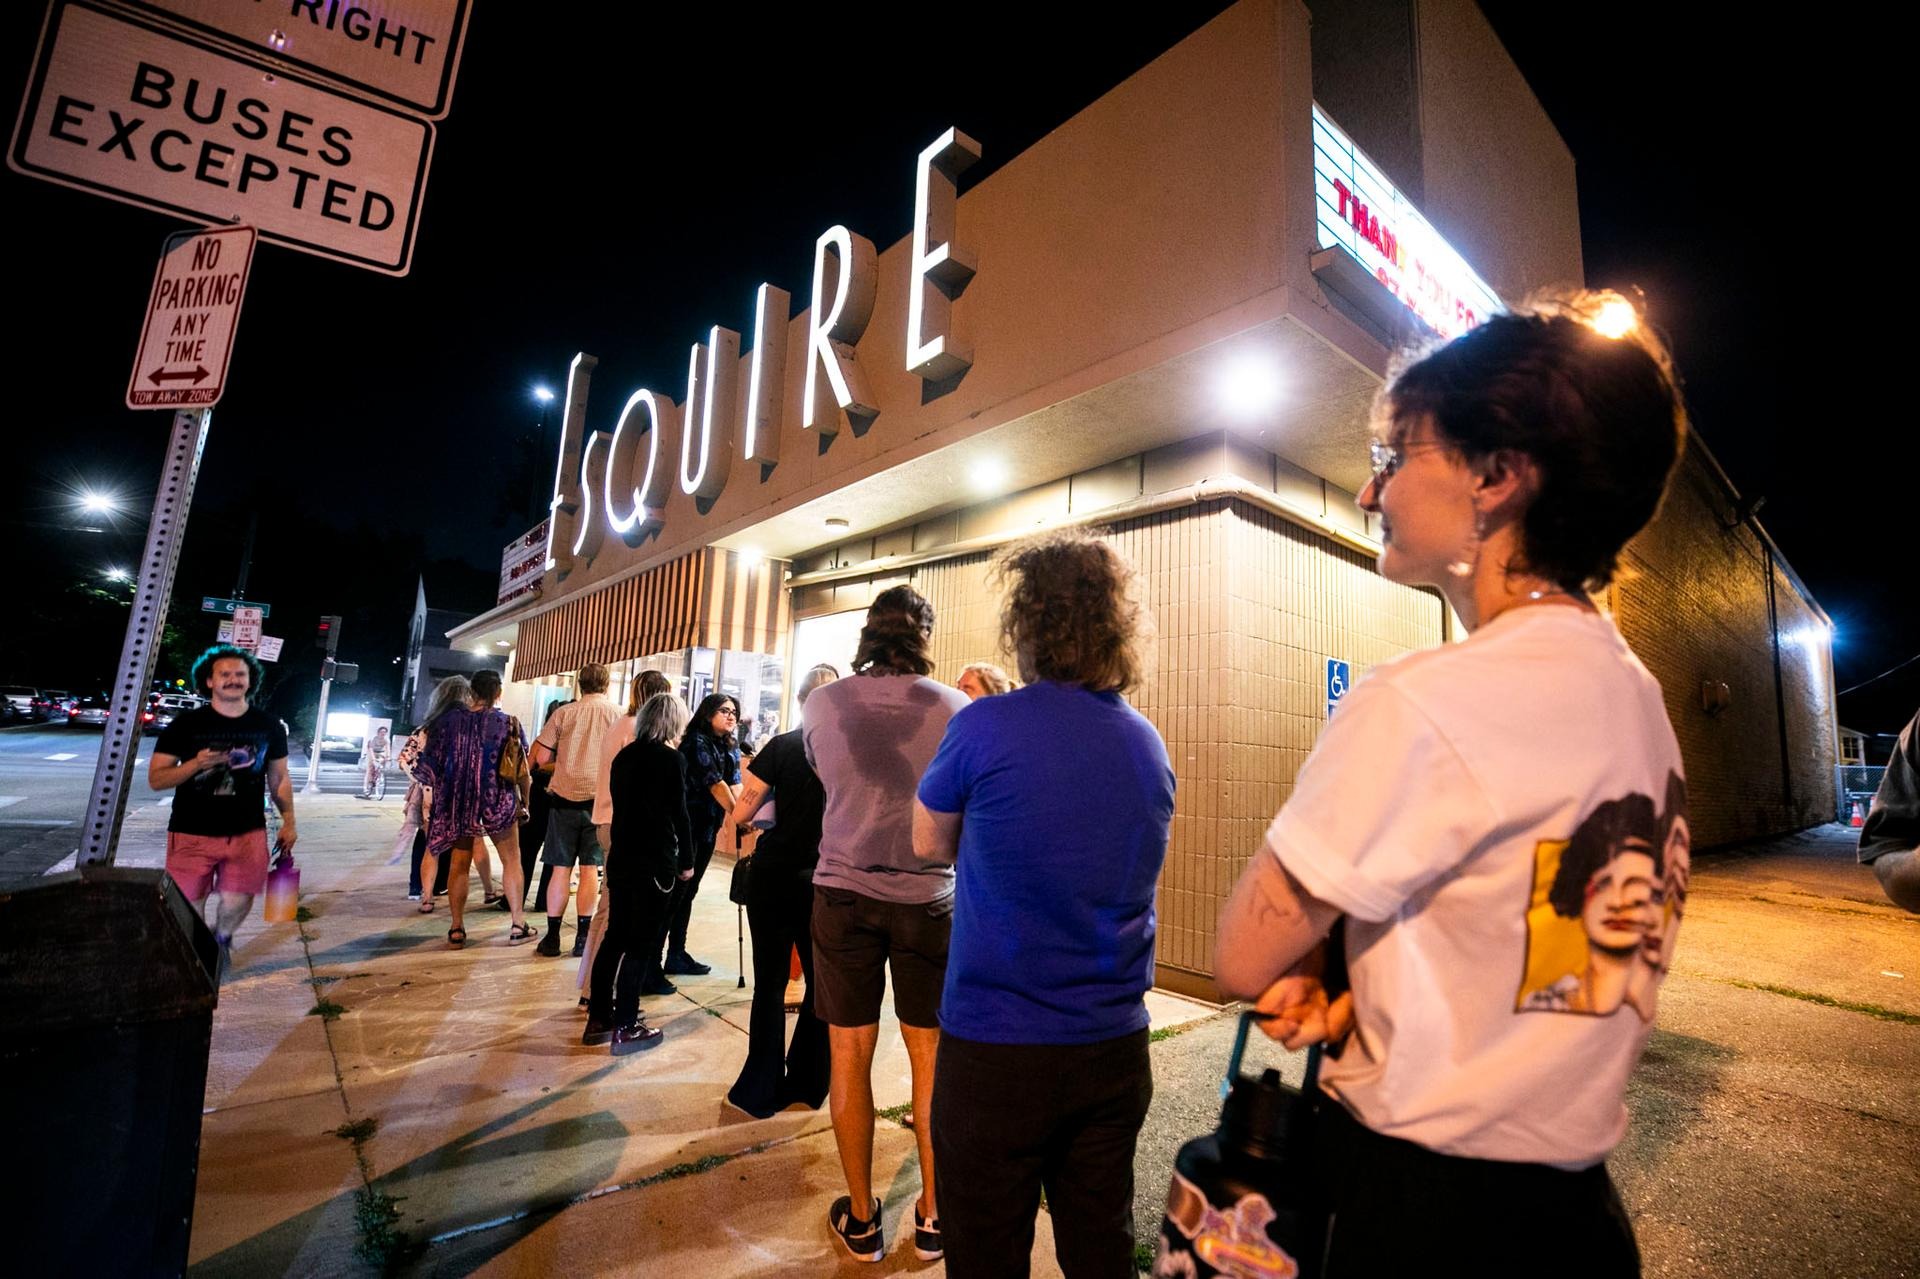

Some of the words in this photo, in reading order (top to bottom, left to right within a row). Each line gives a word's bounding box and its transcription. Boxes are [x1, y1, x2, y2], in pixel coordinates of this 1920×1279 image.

[291, 0, 436, 65] RIGHT
[130, 61, 353, 167] BUSES
[49, 95, 395, 231] EXCEPTED
[1333, 177, 1407, 273] THAN
[191, 238, 222, 271] NO
[157, 273, 240, 309] PARKING
[171, 313, 211, 336] ANY
[545, 126, 982, 571] ESQUIRE
[164, 340, 206, 363] TIME
[134, 391, 155, 403] TOW
[158, 390, 185, 402] AWAY
[188, 389, 215, 401] ZONE
